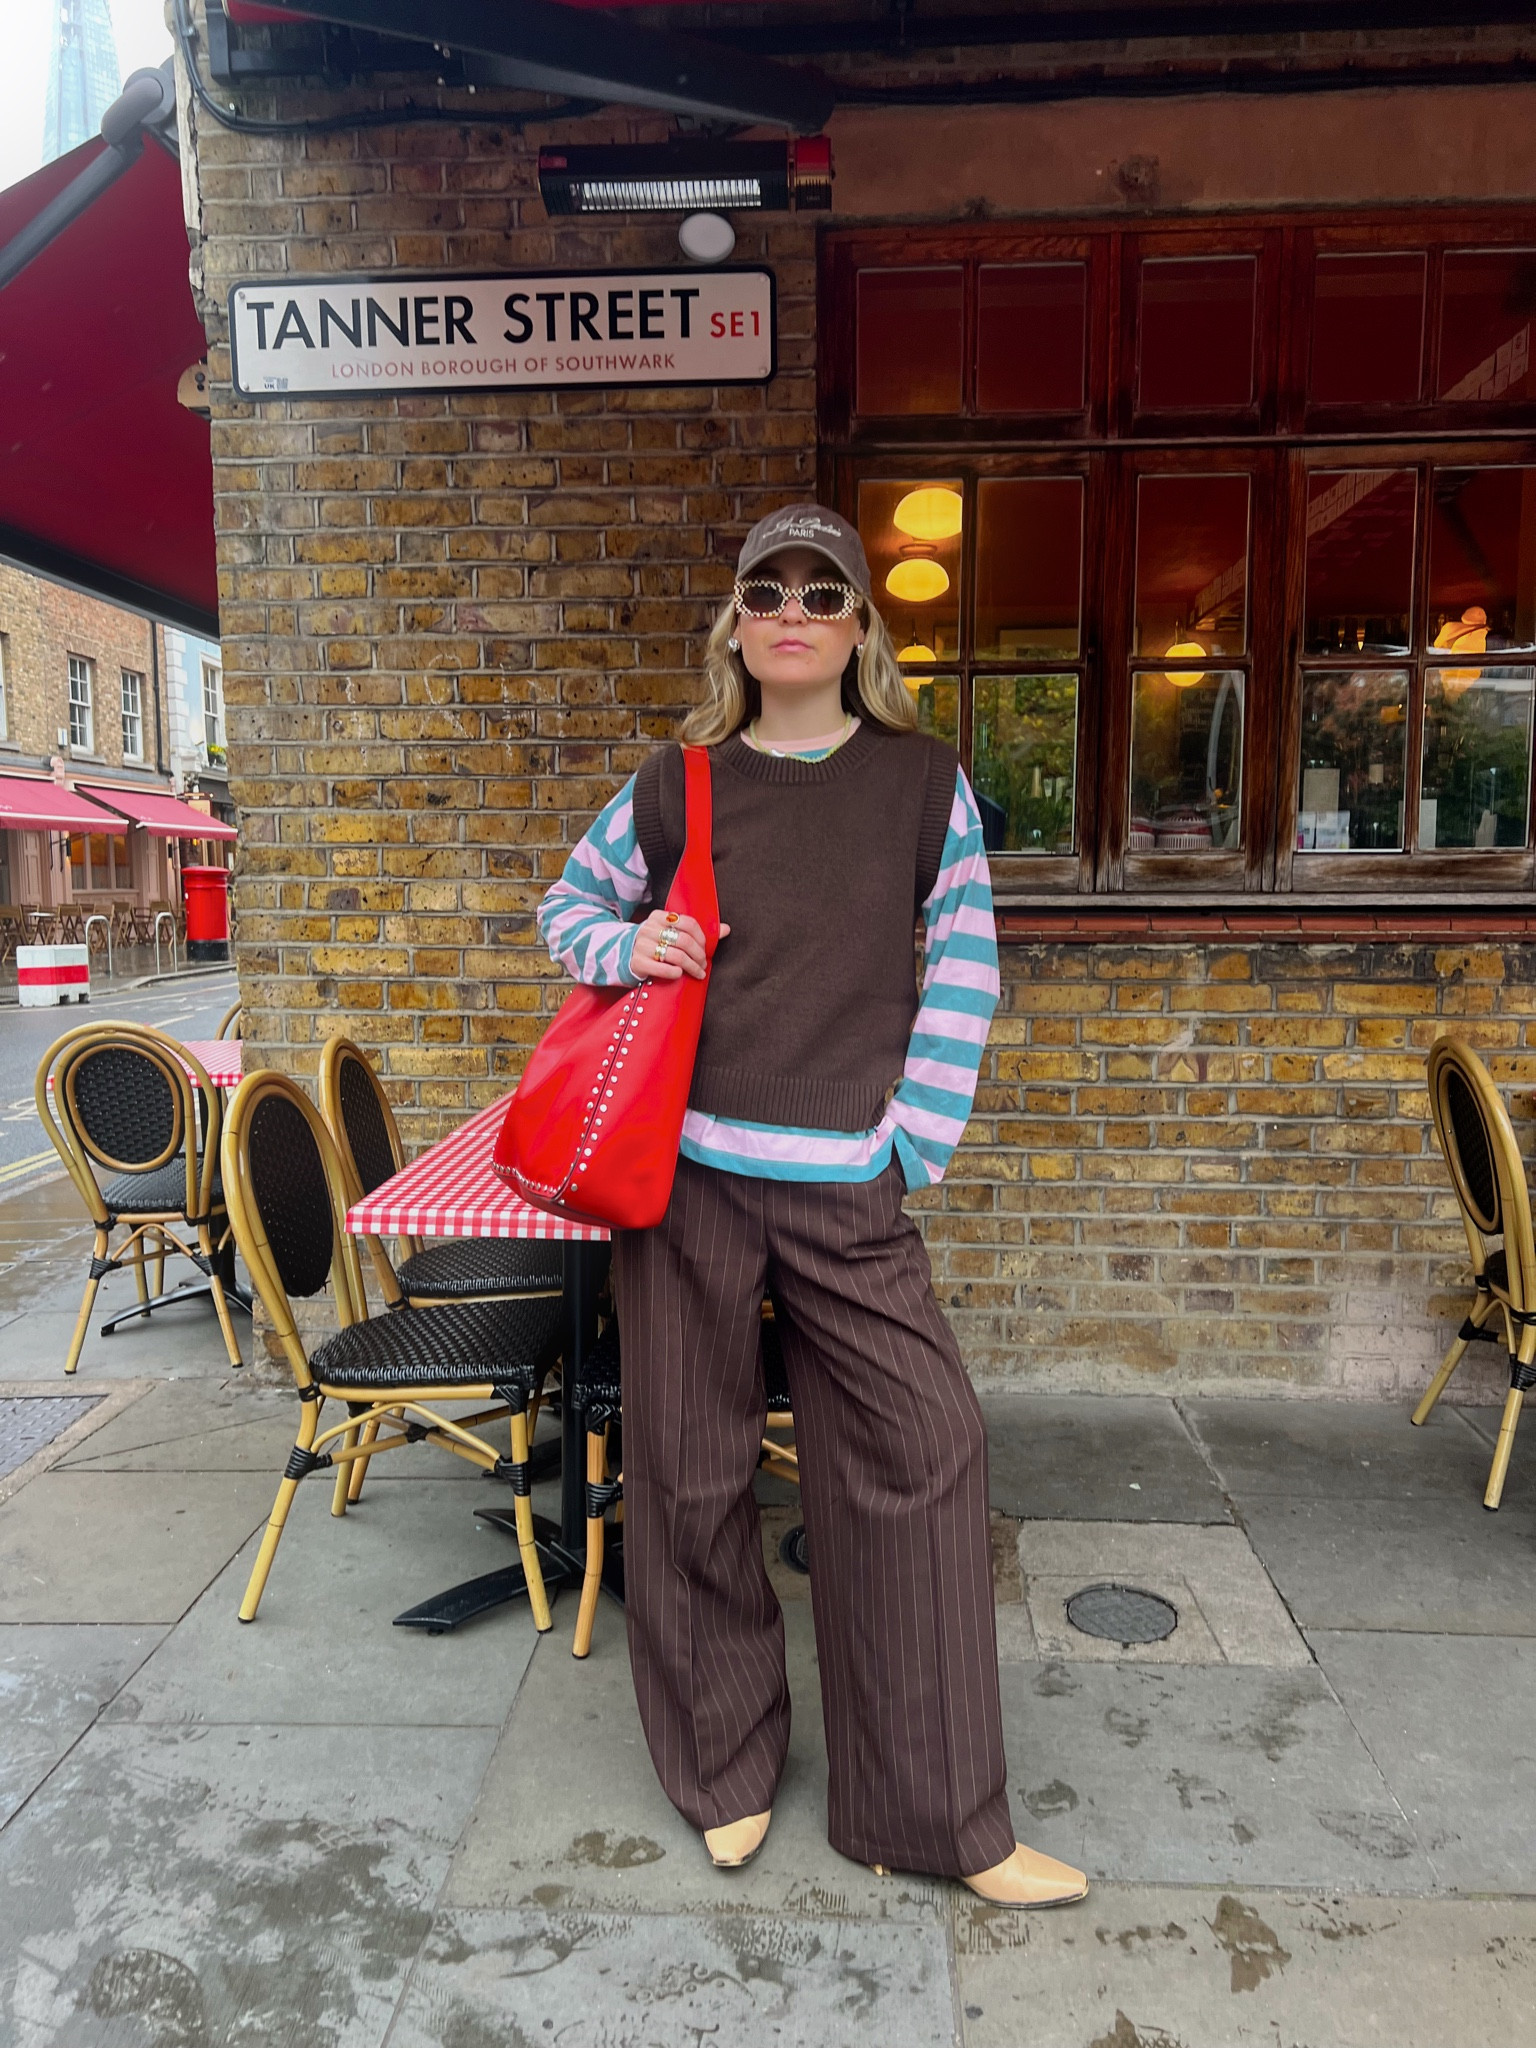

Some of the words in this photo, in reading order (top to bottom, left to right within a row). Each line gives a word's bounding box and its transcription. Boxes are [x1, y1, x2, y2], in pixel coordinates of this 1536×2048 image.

[246, 295, 478, 350] TANNER
[503, 288, 700, 344] STREET
[709, 311, 760, 339] SE1
[332, 361, 414, 379] LONDON
[421, 357, 517, 376] BOROUGH
[523, 357, 548, 373] OF
[555, 353, 676, 372] SOUTHWARK
[789, 528, 815, 538] PARIS
